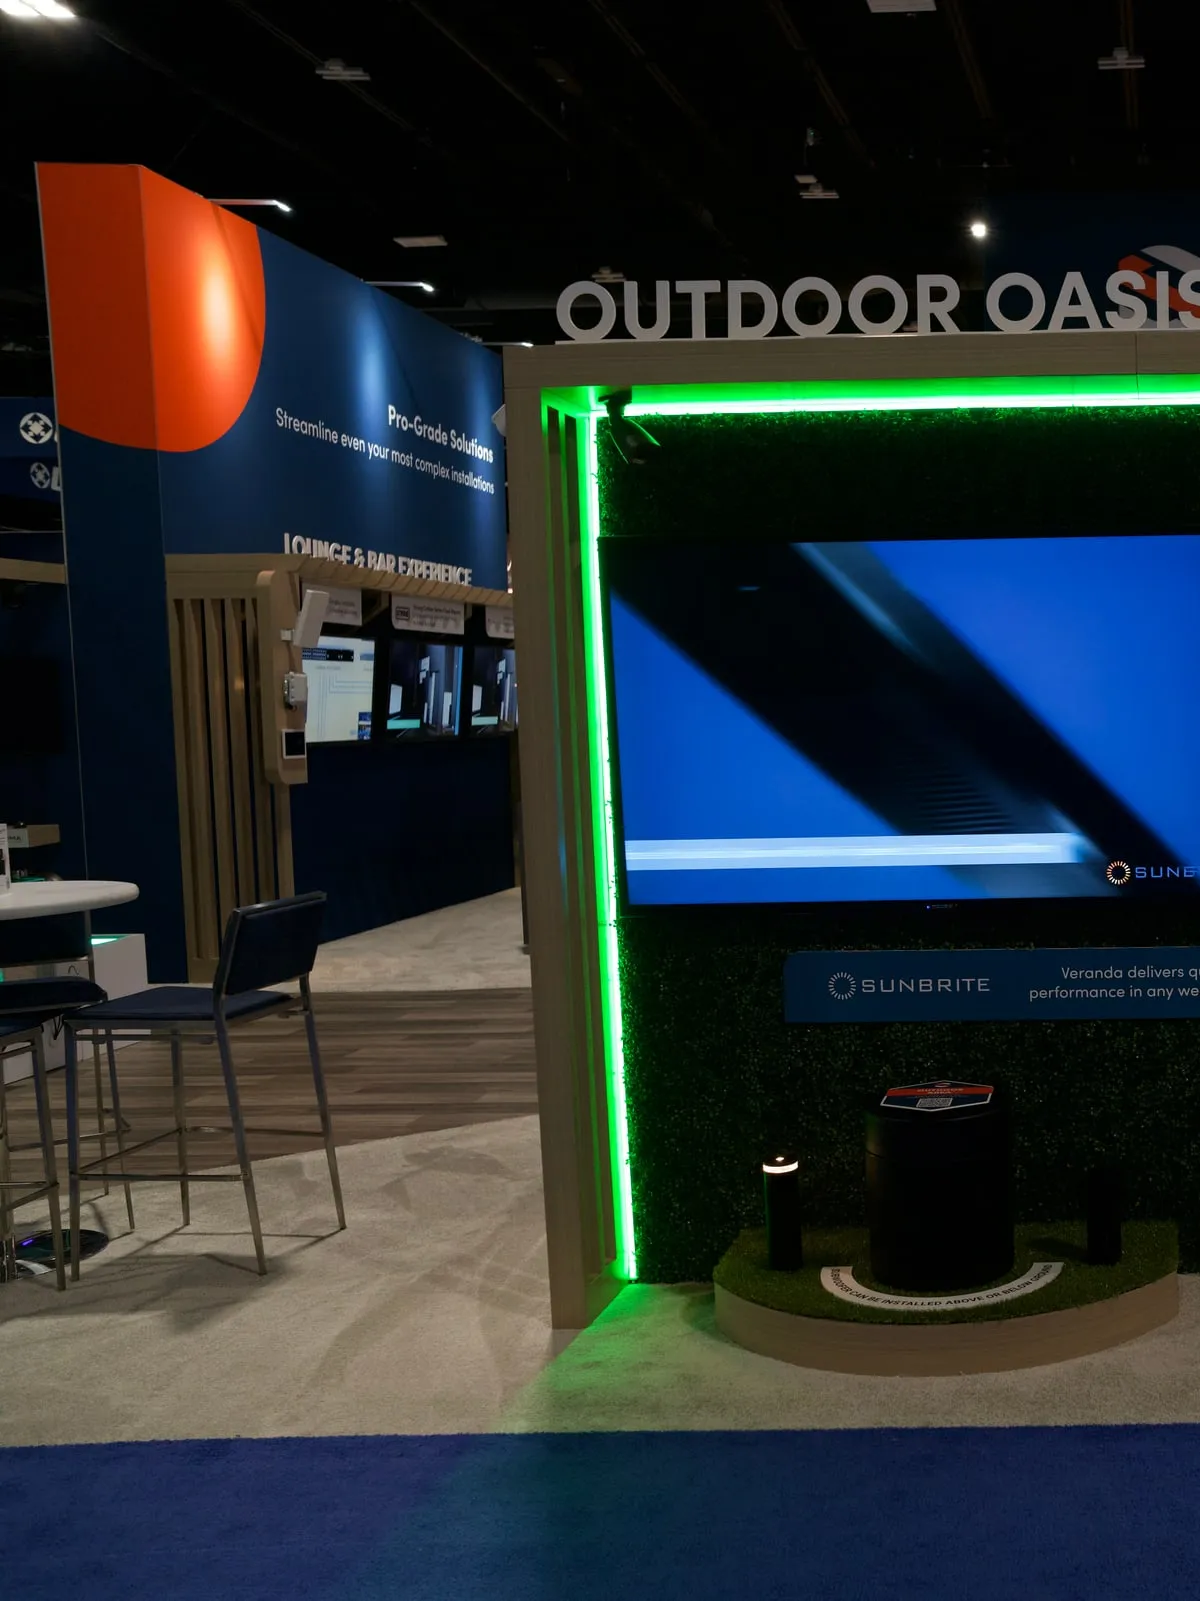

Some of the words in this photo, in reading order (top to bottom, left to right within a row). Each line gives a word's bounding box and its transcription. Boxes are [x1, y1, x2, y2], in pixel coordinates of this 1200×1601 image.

[556, 274, 961, 341] OUTDOOR
[276, 407, 338, 444] Streamline
[341, 433, 366, 453] even
[368, 442, 389, 461] your
[391, 449, 413, 468] most
[415, 457, 450, 480] complex
[451, 466, 494, 494] installations
[388, 404, 448, 445] Pro-Grade
[450, 429, 494, 464] Solutions
[284, 532, 351, 565] LOUNGE
[354, 547, 365, 569] &
[367, 550, 396, 574] BAR
[398, 556, 472, 586] EXPERIENCE
[861, 978, 991, 993] SUNBRITE
[1061, 966, 1124, 980] Veranda
[1128, 964, 1184, 979] delivers
[1029, 986, 1125, 1002] performance
[1129, 986, 1142, 998] in
[1146, 988, 1174, 1001] any
[849, 1290, 868, 1300] CAN
[946, 1296, 984, 1305] ABOVE
[1001, 1281, 1032, 1295] BELOW
